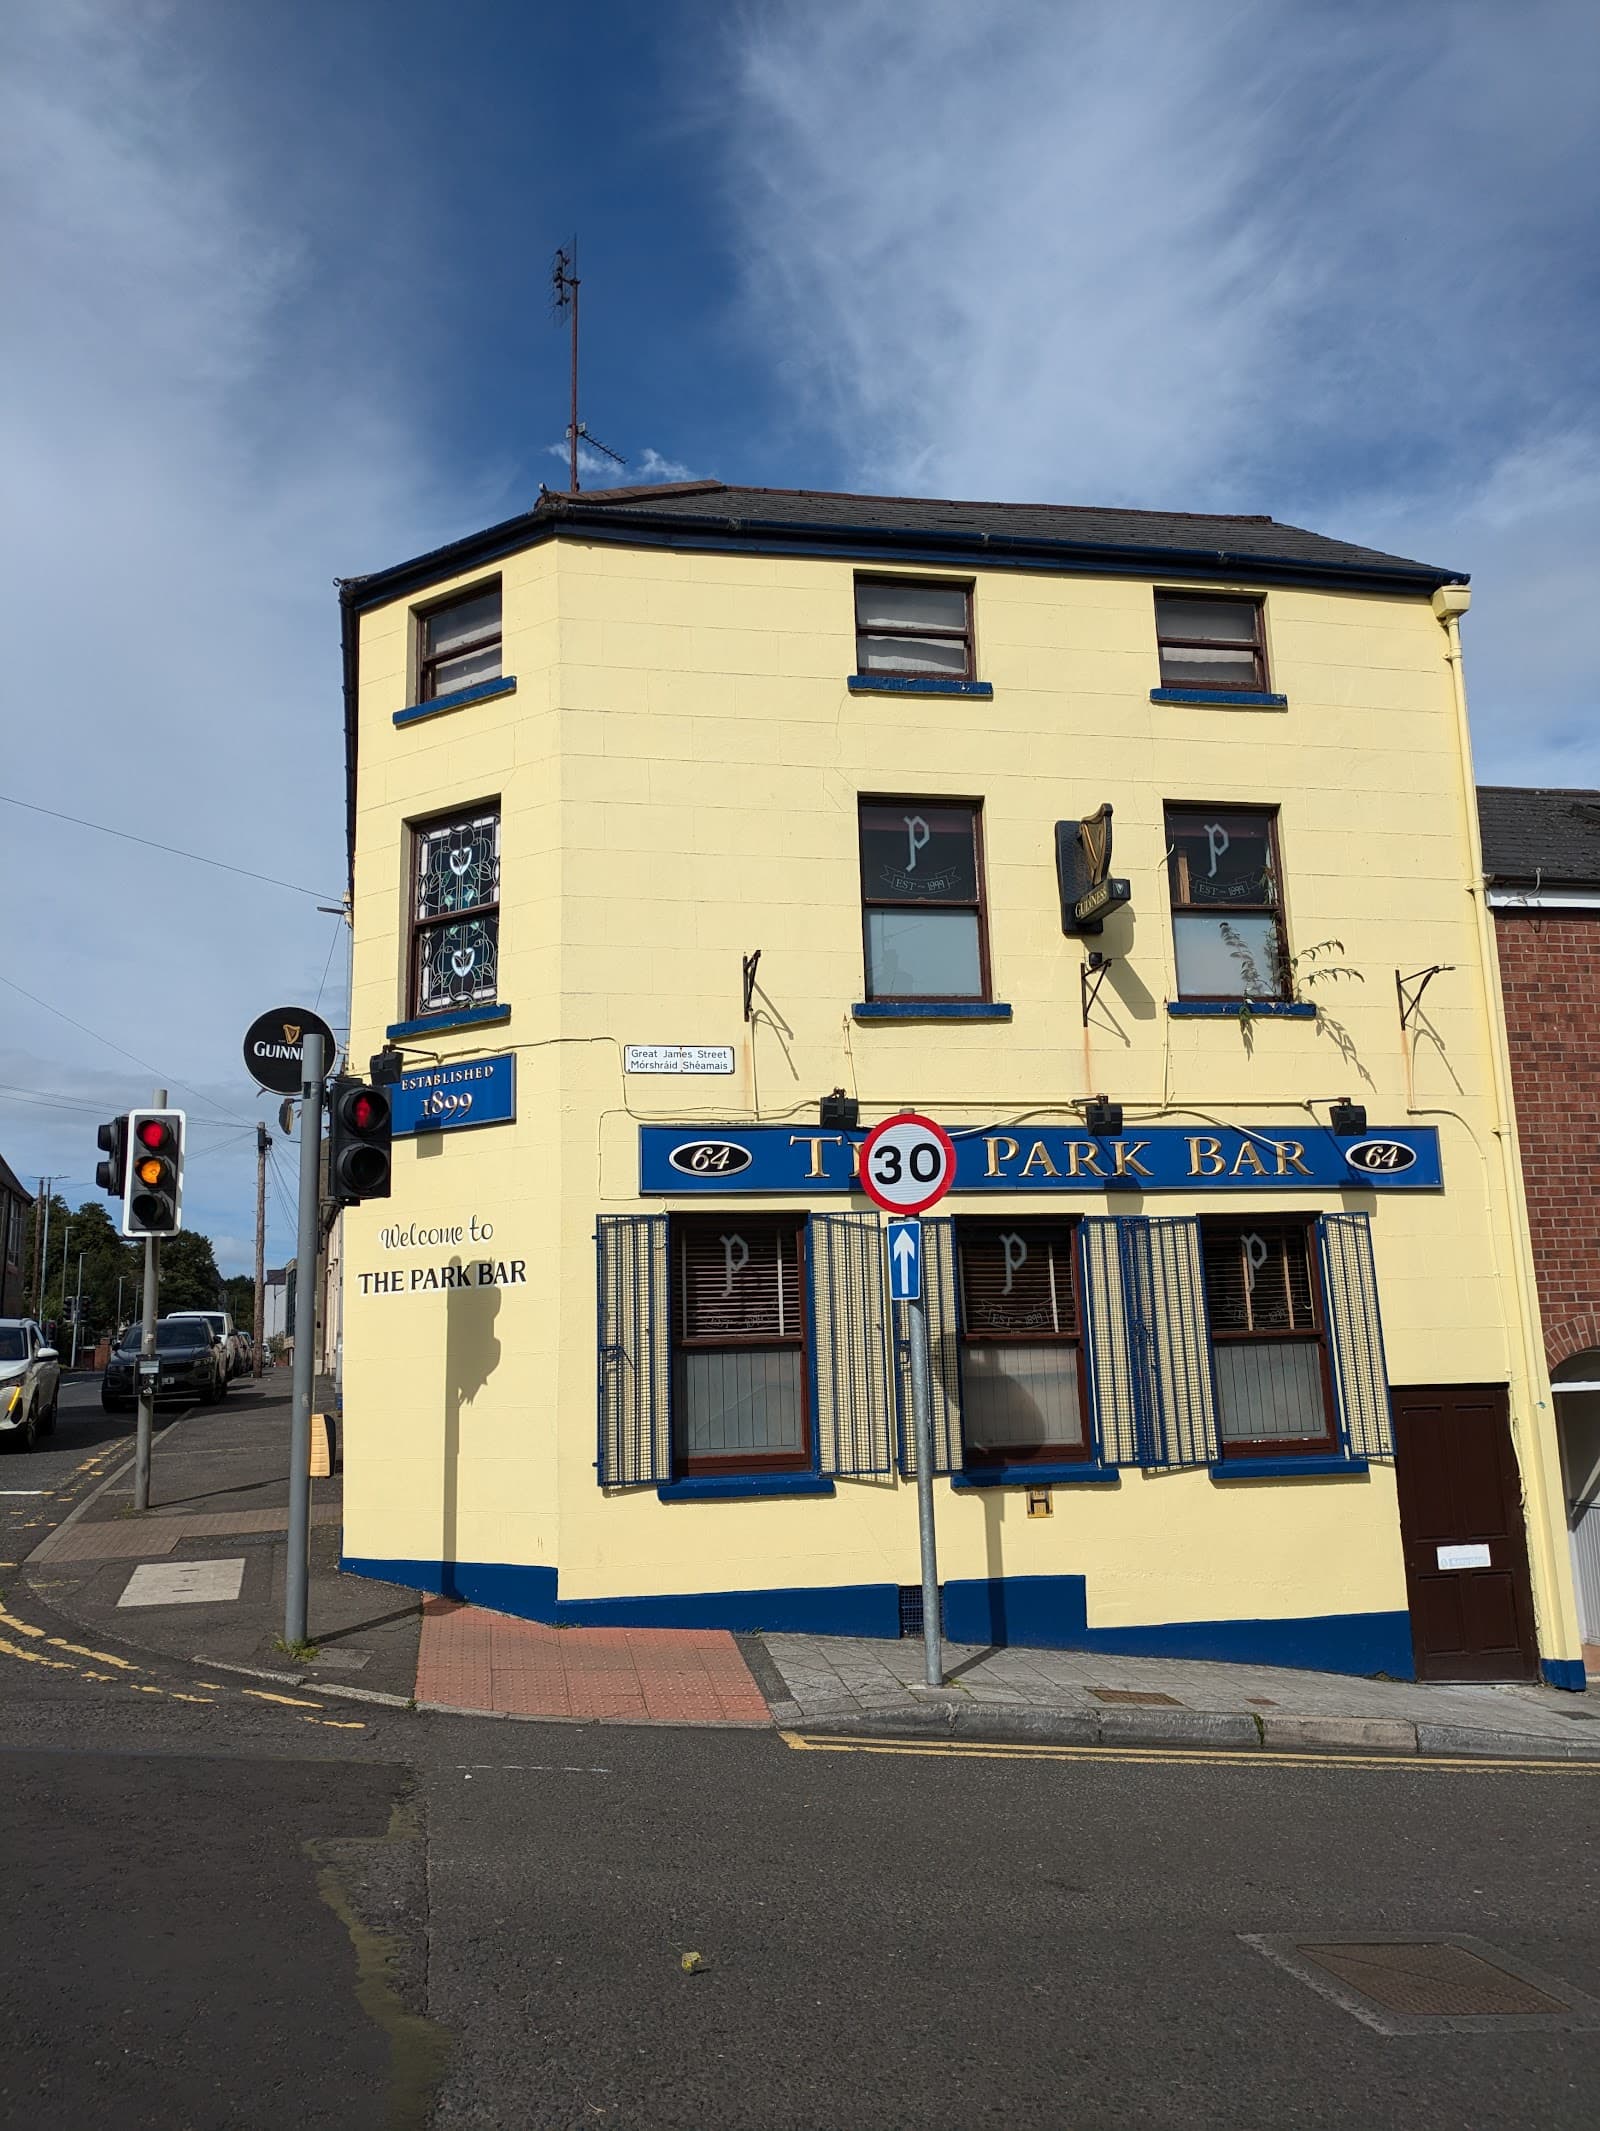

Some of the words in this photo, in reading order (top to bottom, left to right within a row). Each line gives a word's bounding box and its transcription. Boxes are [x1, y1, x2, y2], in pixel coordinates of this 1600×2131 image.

[895, 878, 917, 891] EST
[253, 1040, 303, 1061] GUINN
[631, 1049, 658, 1058] Great
[663, 1049, 693, 1059] James
[697, 1050, 728, 1059] Street
[401, 1065, 495, 1091] ESTABLISHED
[631, 1060, 678, 1070] Mórshráid
[682, 1060, 728, 1070] Shéamais
[420, 1090, 473, 1120] 1899
[690, 1145, 731, 1171] 64
[873, 1142, 942, 1186] 30
[982, 1136, 1154, 1178] PARK
[1184, 1136, 1315, 1177] BAR
[1363, 1146, 1399, 1168] 64
[380, 1222, 463, 1249] Welcome
[469, 1214, 494, 1242] to
[357, 1270, 404, 1294] THE
[411, 1264, 472, 1290] PARK
[478, 1260, 527, 1286] BAR
